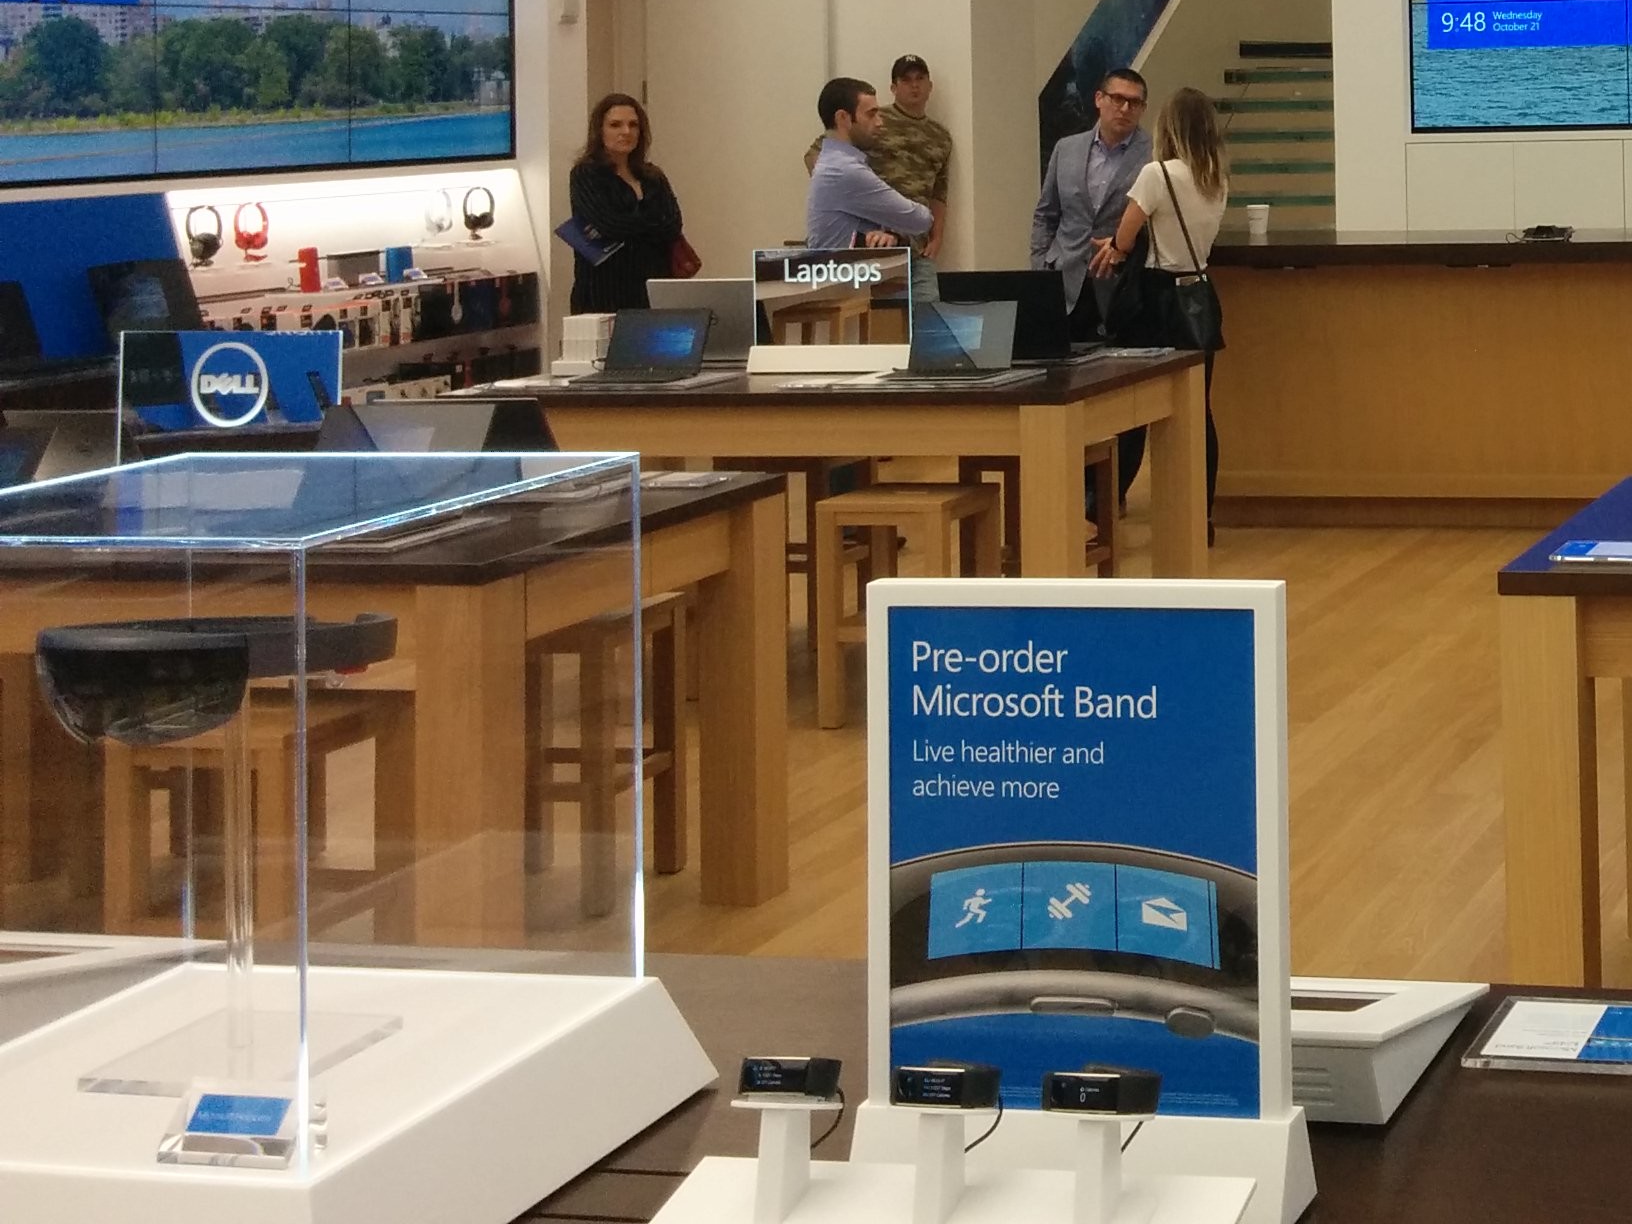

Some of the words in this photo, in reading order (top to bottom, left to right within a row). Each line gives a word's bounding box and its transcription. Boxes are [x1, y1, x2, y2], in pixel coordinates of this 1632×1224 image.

[1441, 11, 1486, 33] 9:48
[1492, 10, 1543, 21] Wednesday
[1492, 21, 1528, 32] October
[1530, 21, 1540, 31] 21
[783, 257, 882, 290] Laptops
[200, 374, 260, 395] DELL
[911, 640, 1068, 675] Pre-order
[911, 683, 1064, 719] Microsoft
[1074, 685, 1158, 720] Band
[912, 739, 955, 764] Live
[960, 739, 1056, 765] healthier
[1062, 741, 1105, 766] and
[911, 773, 996, 799] achieve
[1001, 780, 1060, 800] more
